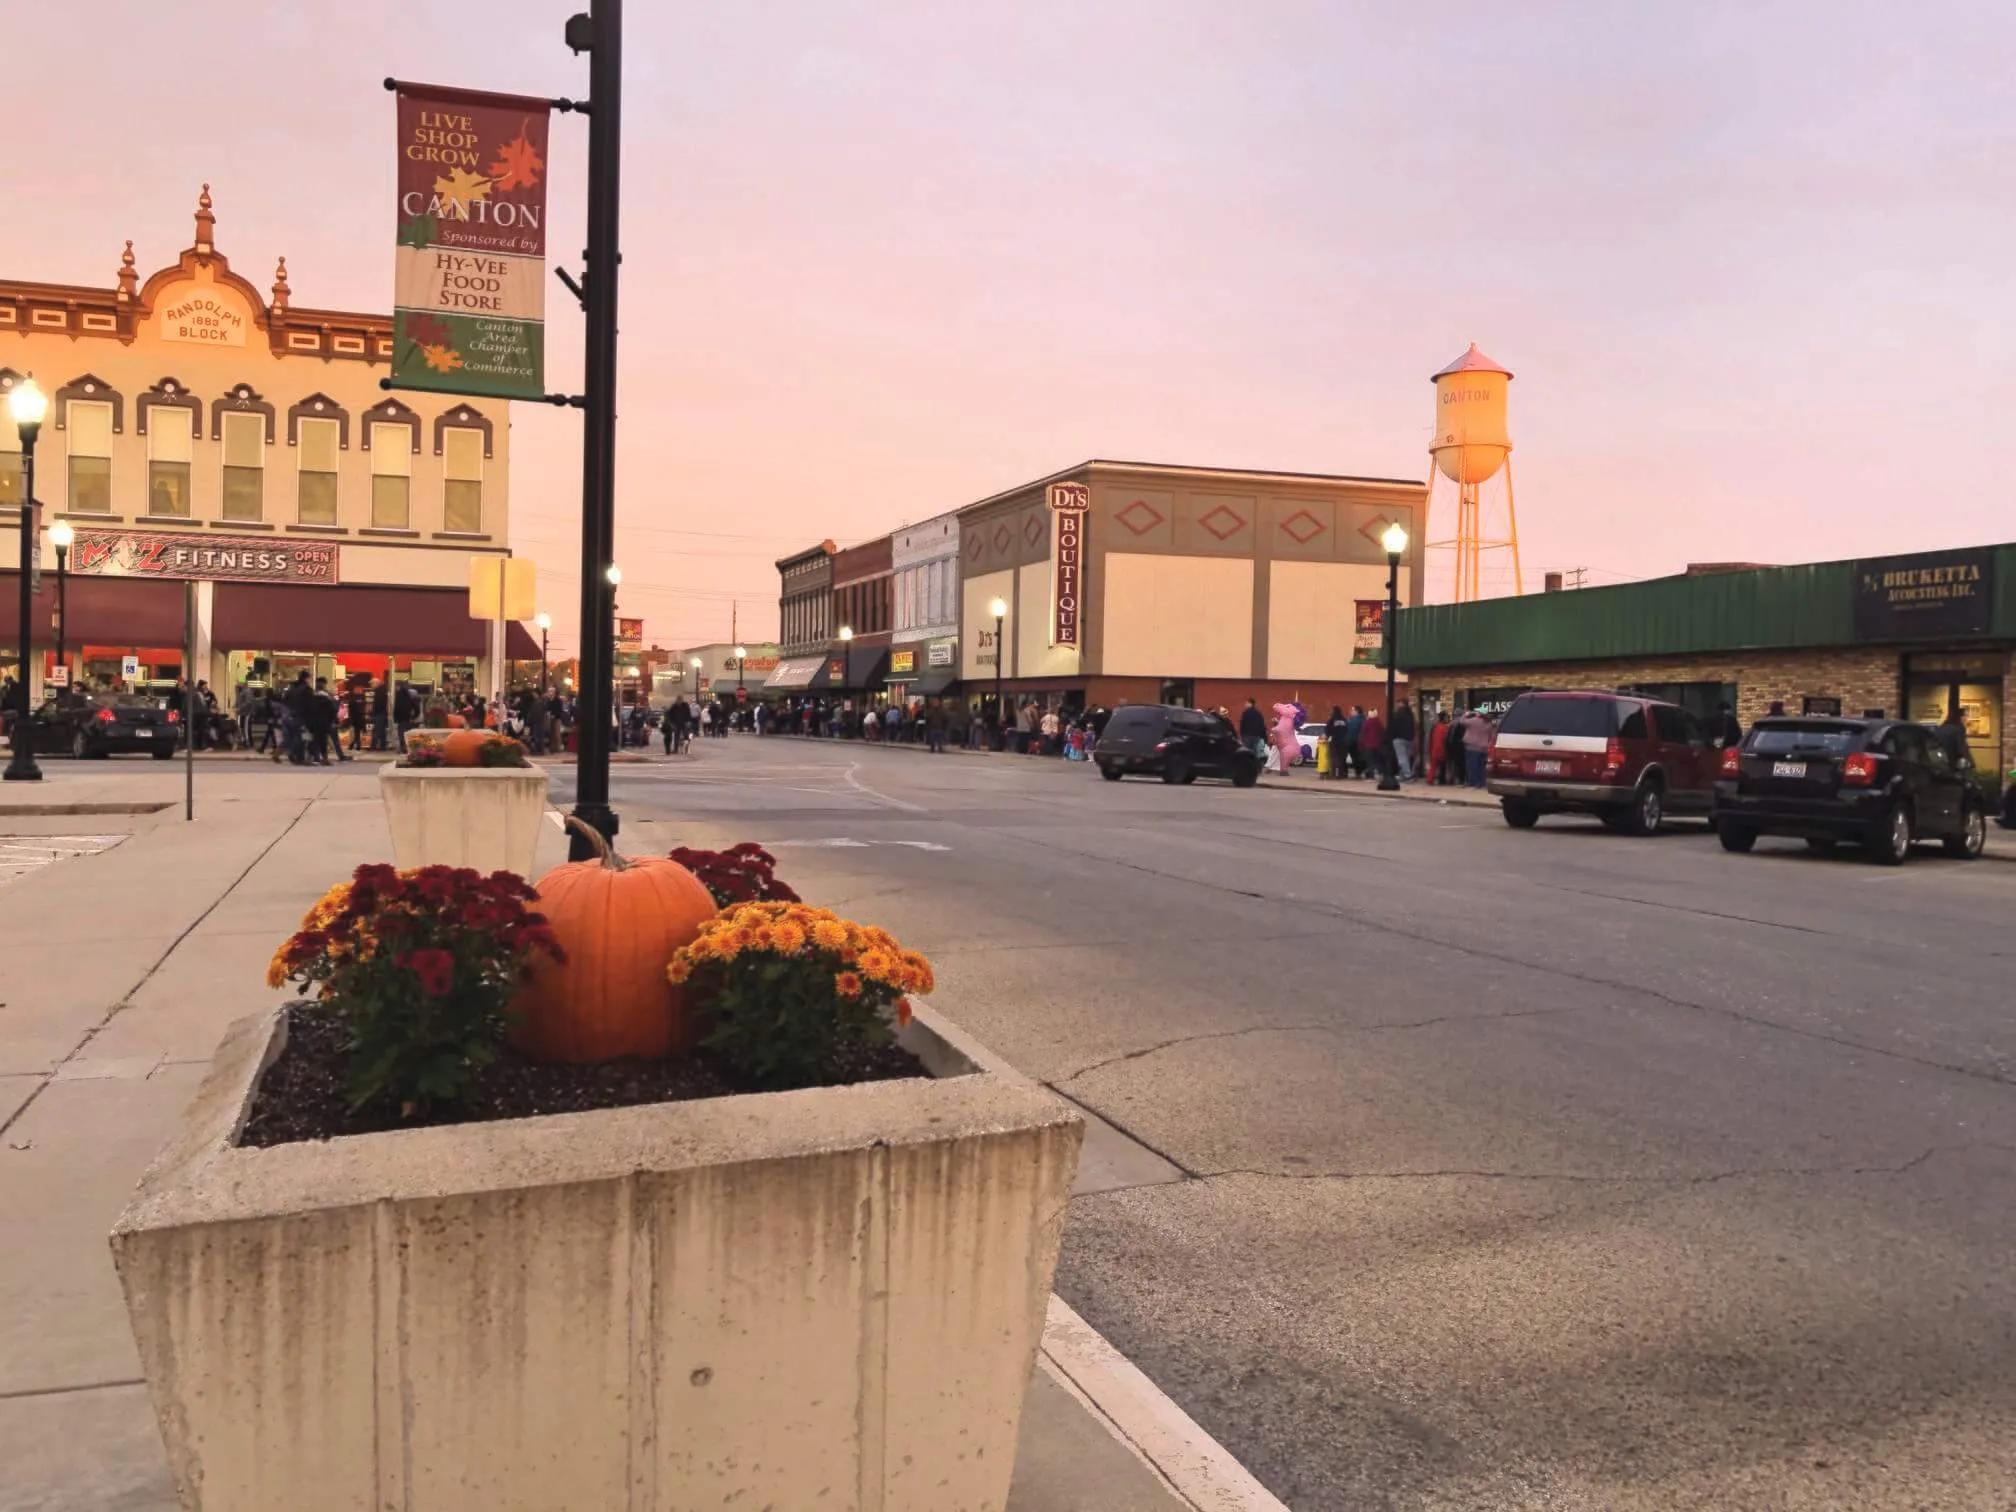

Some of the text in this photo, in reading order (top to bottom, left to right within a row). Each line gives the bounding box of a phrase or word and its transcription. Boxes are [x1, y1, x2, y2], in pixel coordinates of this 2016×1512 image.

[420, 112, 473, 132] LIVE
[415, 128, 479, 149] SHOP
[407, 145, 480, 166] GROW
[402, 192, 541, 229] CANTON
[443, 230, 538, 252] Sponsored by
[436, 254, 508, 275] HY-VEE
[443, 272, 501, 292] FOOD
[439, 291, 502, 310] STORE
[167, 300, 241, 328] RANDOLPH
[179, 327, 228, 341] BLOCK
[476, 320, 523, 334] Canton
[487, 331, 516, 343] Area
[469, 341, 529, 354] Chamber
[464, 359, 534, 376] Commerce
[492, 354, 506, 365] of
[175, 550, 288, 570] FITNESS
[295, 551, 330, 563] OPEN
[297, 564, 328, 576] 24/7
[1059, 518, 1077, 641] BOUTIQUE
